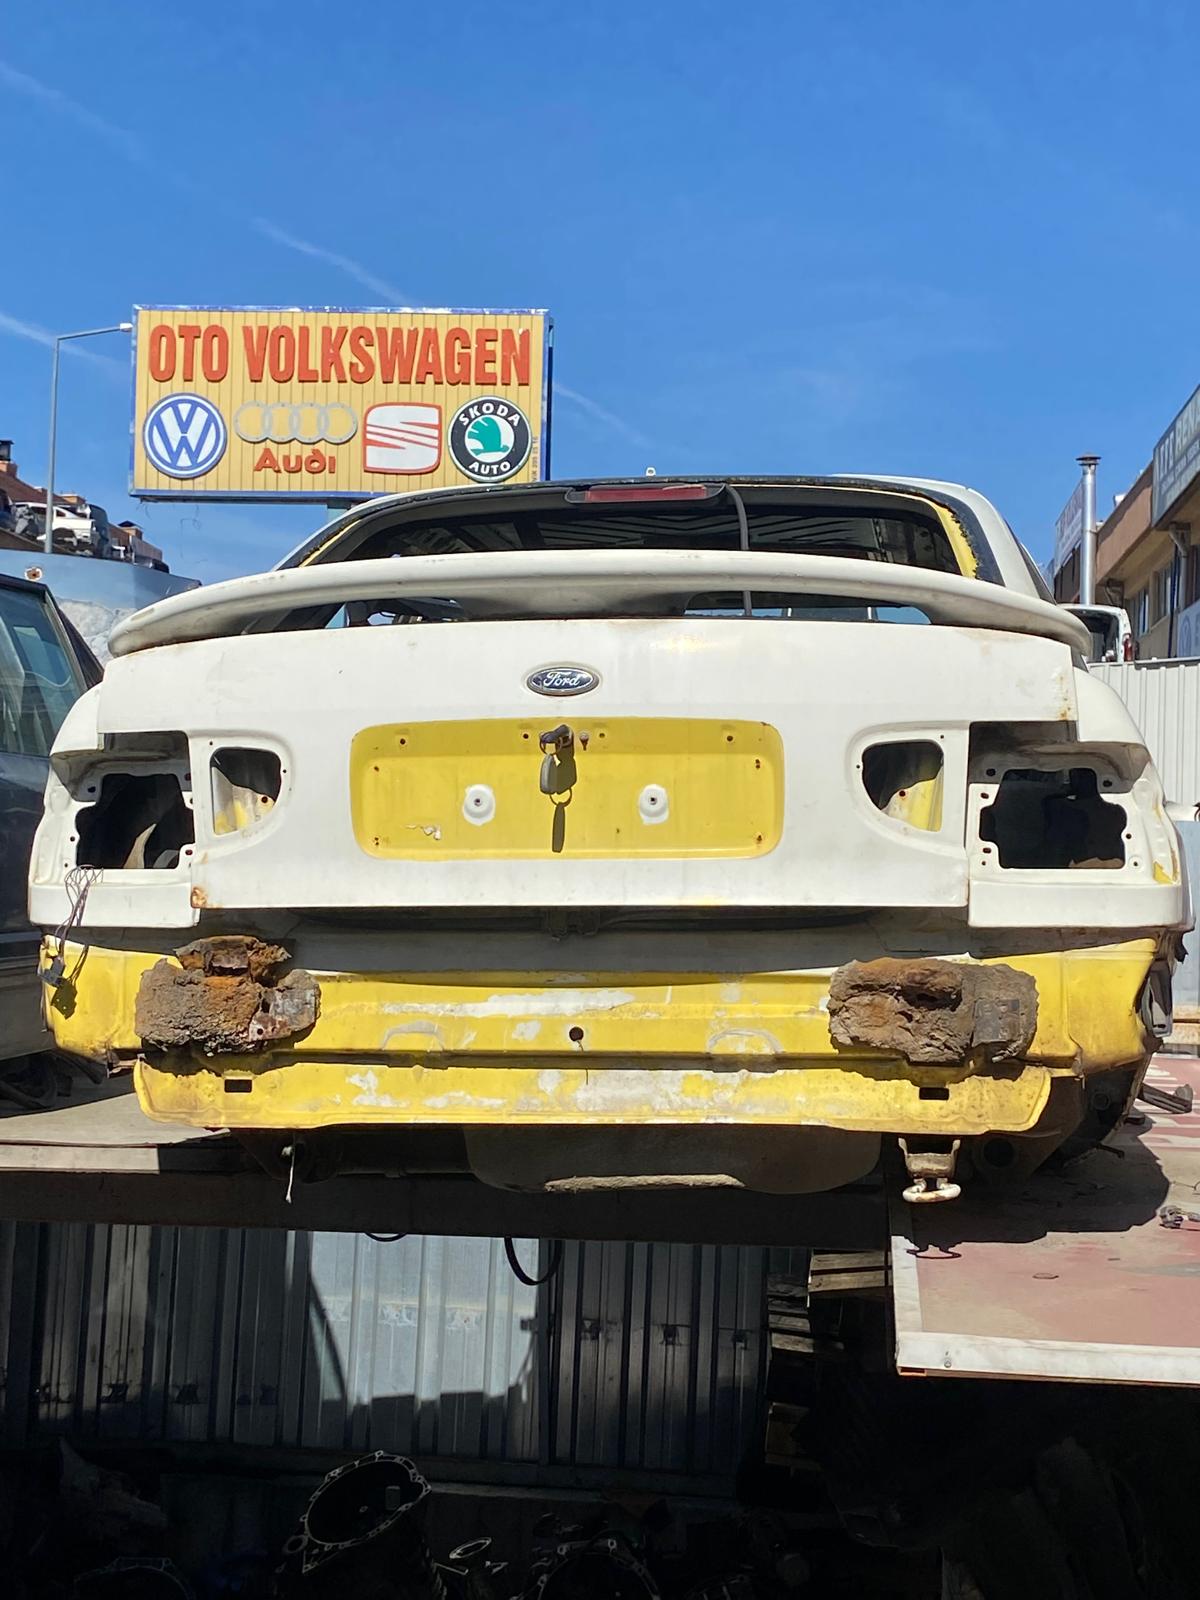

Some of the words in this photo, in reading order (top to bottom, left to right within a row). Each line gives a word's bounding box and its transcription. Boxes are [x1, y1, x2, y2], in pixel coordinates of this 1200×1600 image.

[148, 324, 229, 382] OTO
[241, 325, 531, 386] VOLKSWAGEN
[458, 402, 521, 427] SKODA
[253, 447, 336, 474] Audi
[468, 461, 511, 475] AUTO
[543, 671, 581, 687] Ford
